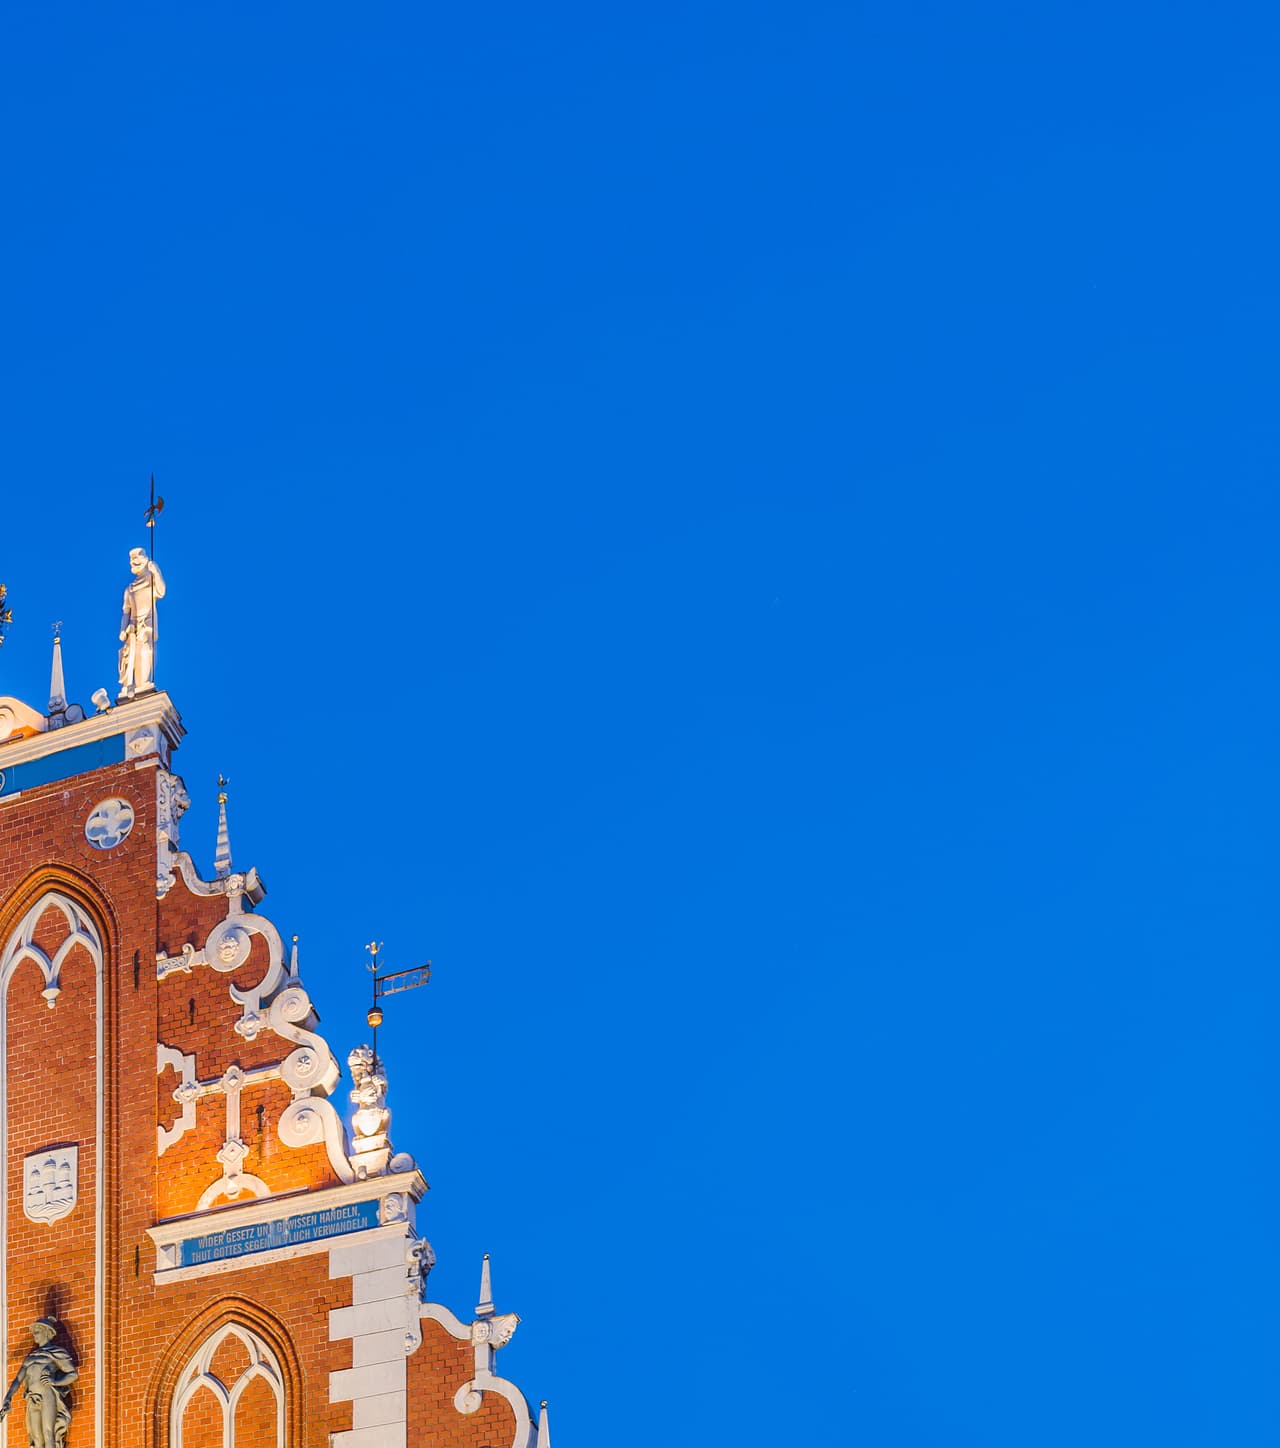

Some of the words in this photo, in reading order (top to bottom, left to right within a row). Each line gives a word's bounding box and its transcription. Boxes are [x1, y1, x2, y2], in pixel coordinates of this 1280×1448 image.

[191, 1249, 211, 1263] THUT
[214, 1243, 244, 1258] GOTTES
[313, 1217, 368, 1237] VERWANDELN
[198, 1234, 224, 1249] WIDER
[226, 1228, 255, 1243] GESETZ
